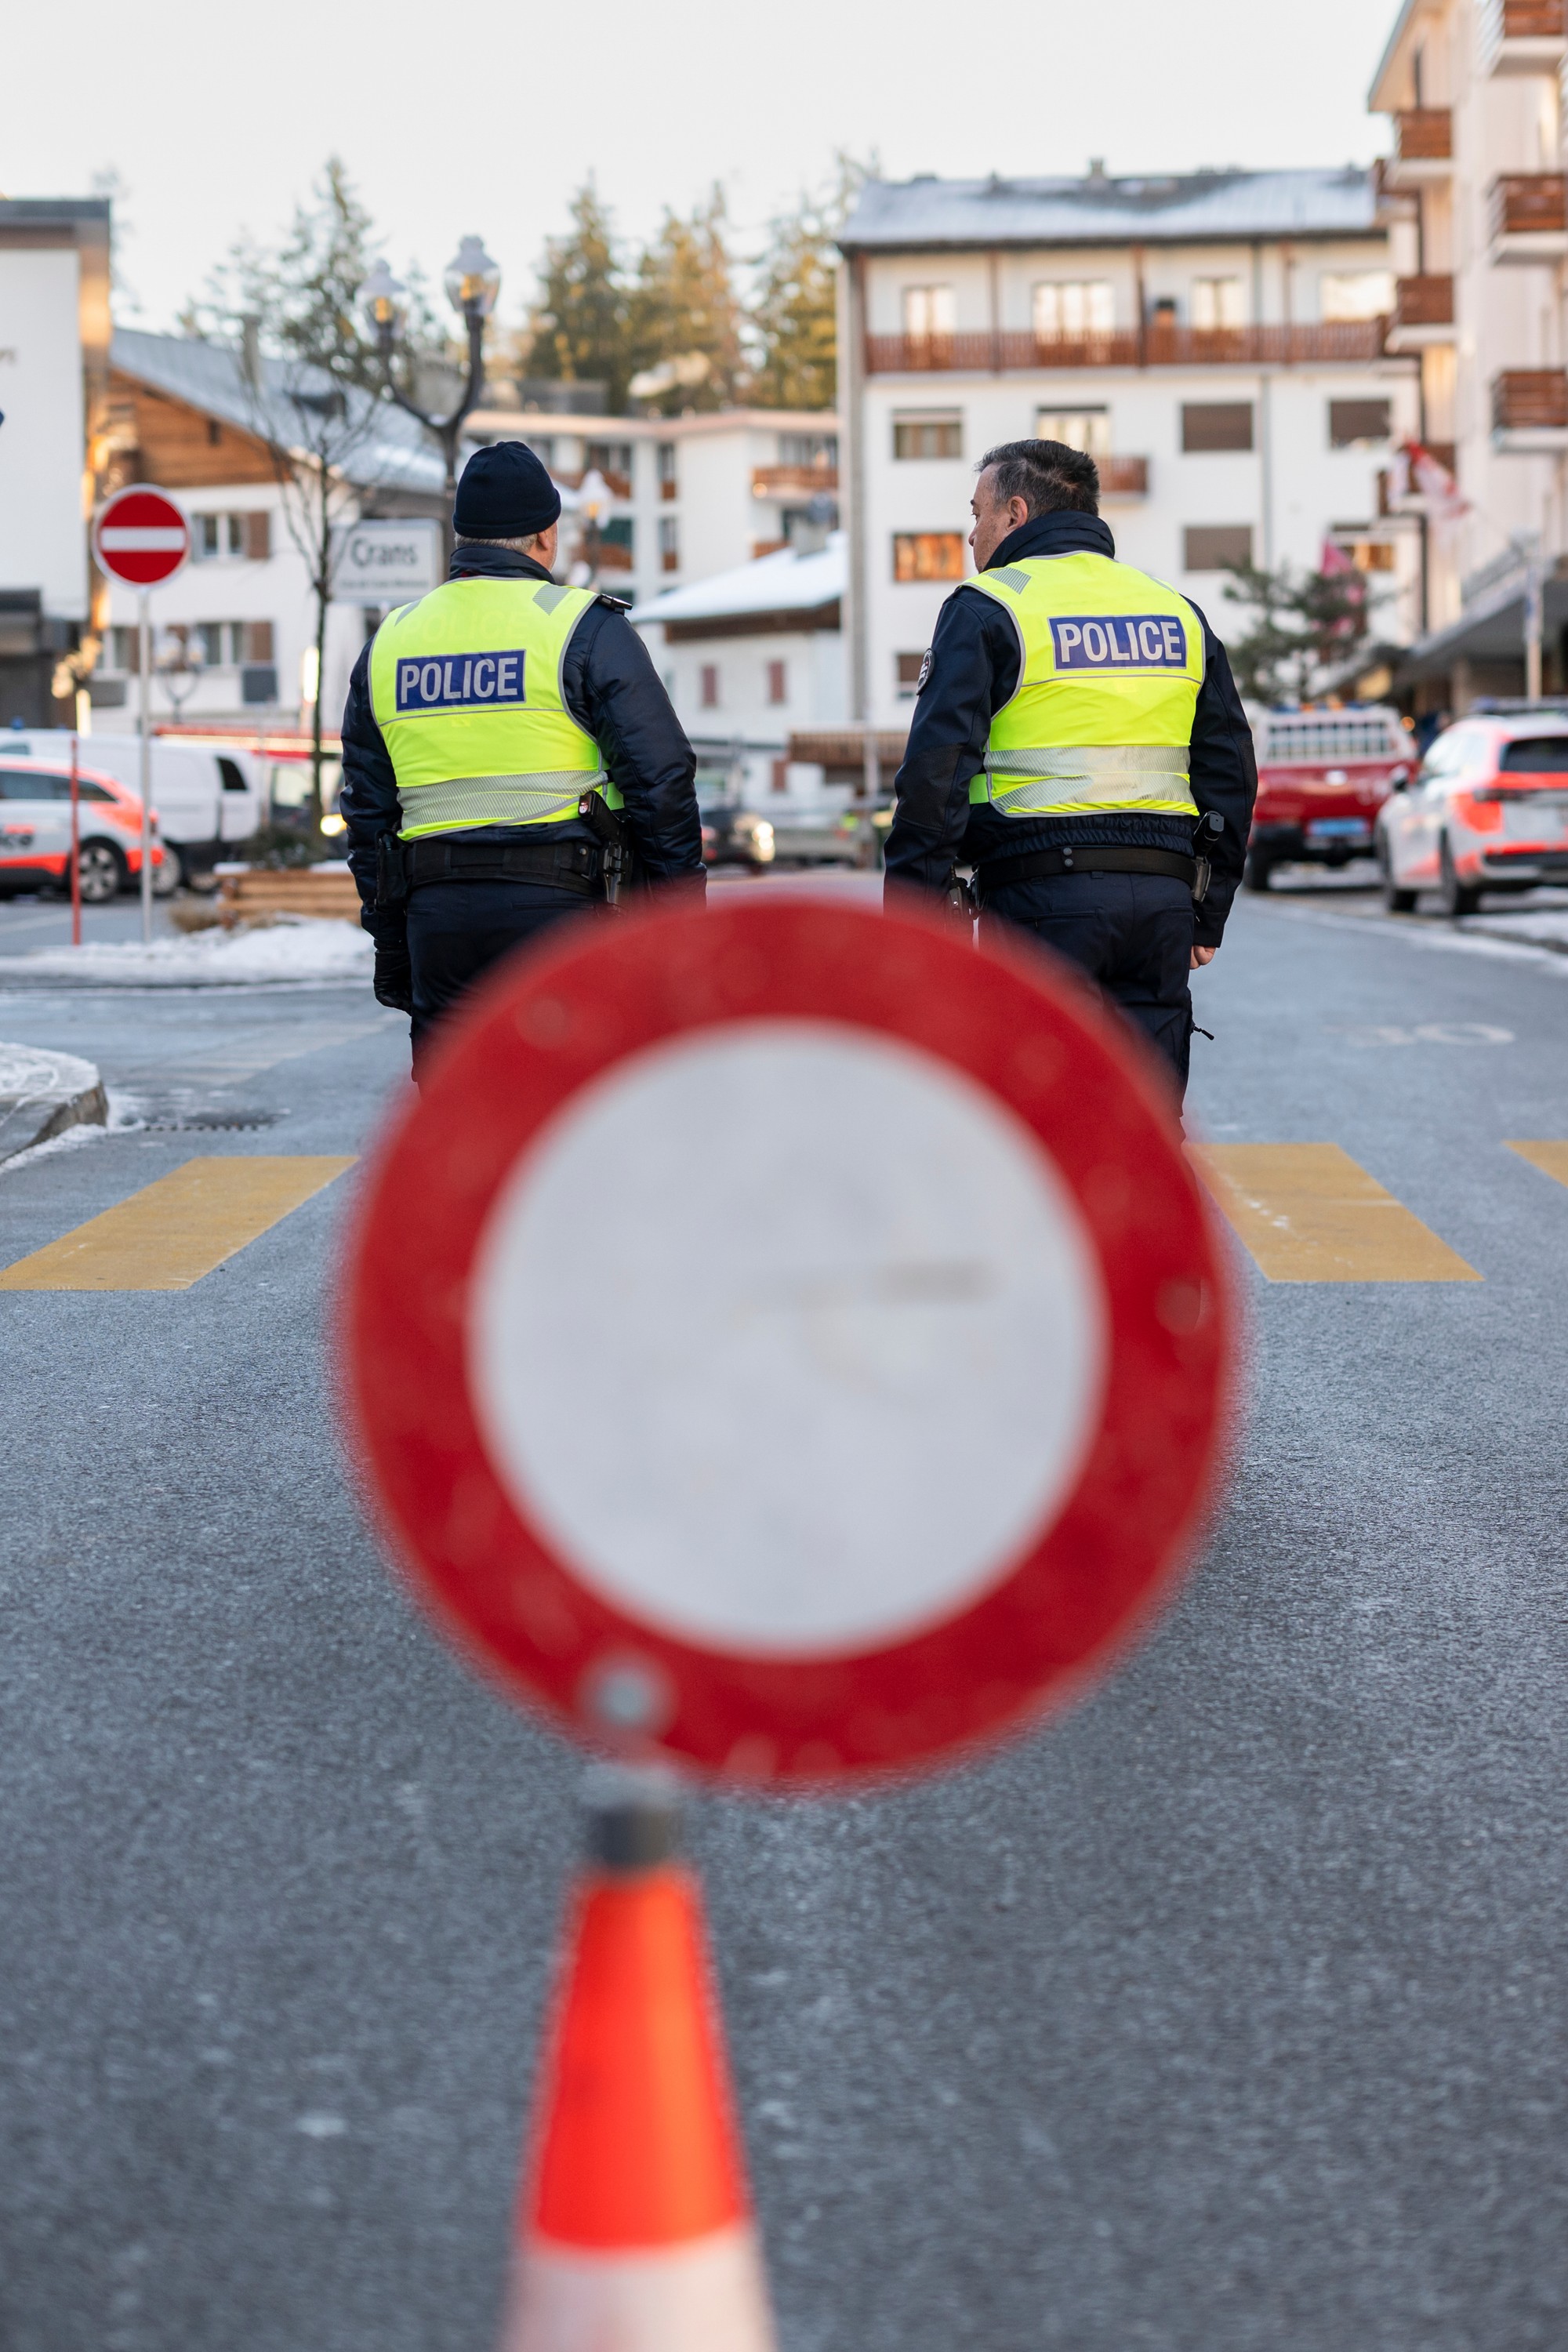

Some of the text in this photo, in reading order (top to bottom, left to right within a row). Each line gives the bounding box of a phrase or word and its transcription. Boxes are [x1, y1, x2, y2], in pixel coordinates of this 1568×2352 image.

[351, 538, 418, 567] Crans
[1056, 621, 1182, 662] POLICE
[401, 657, 518, 704] POLICE
